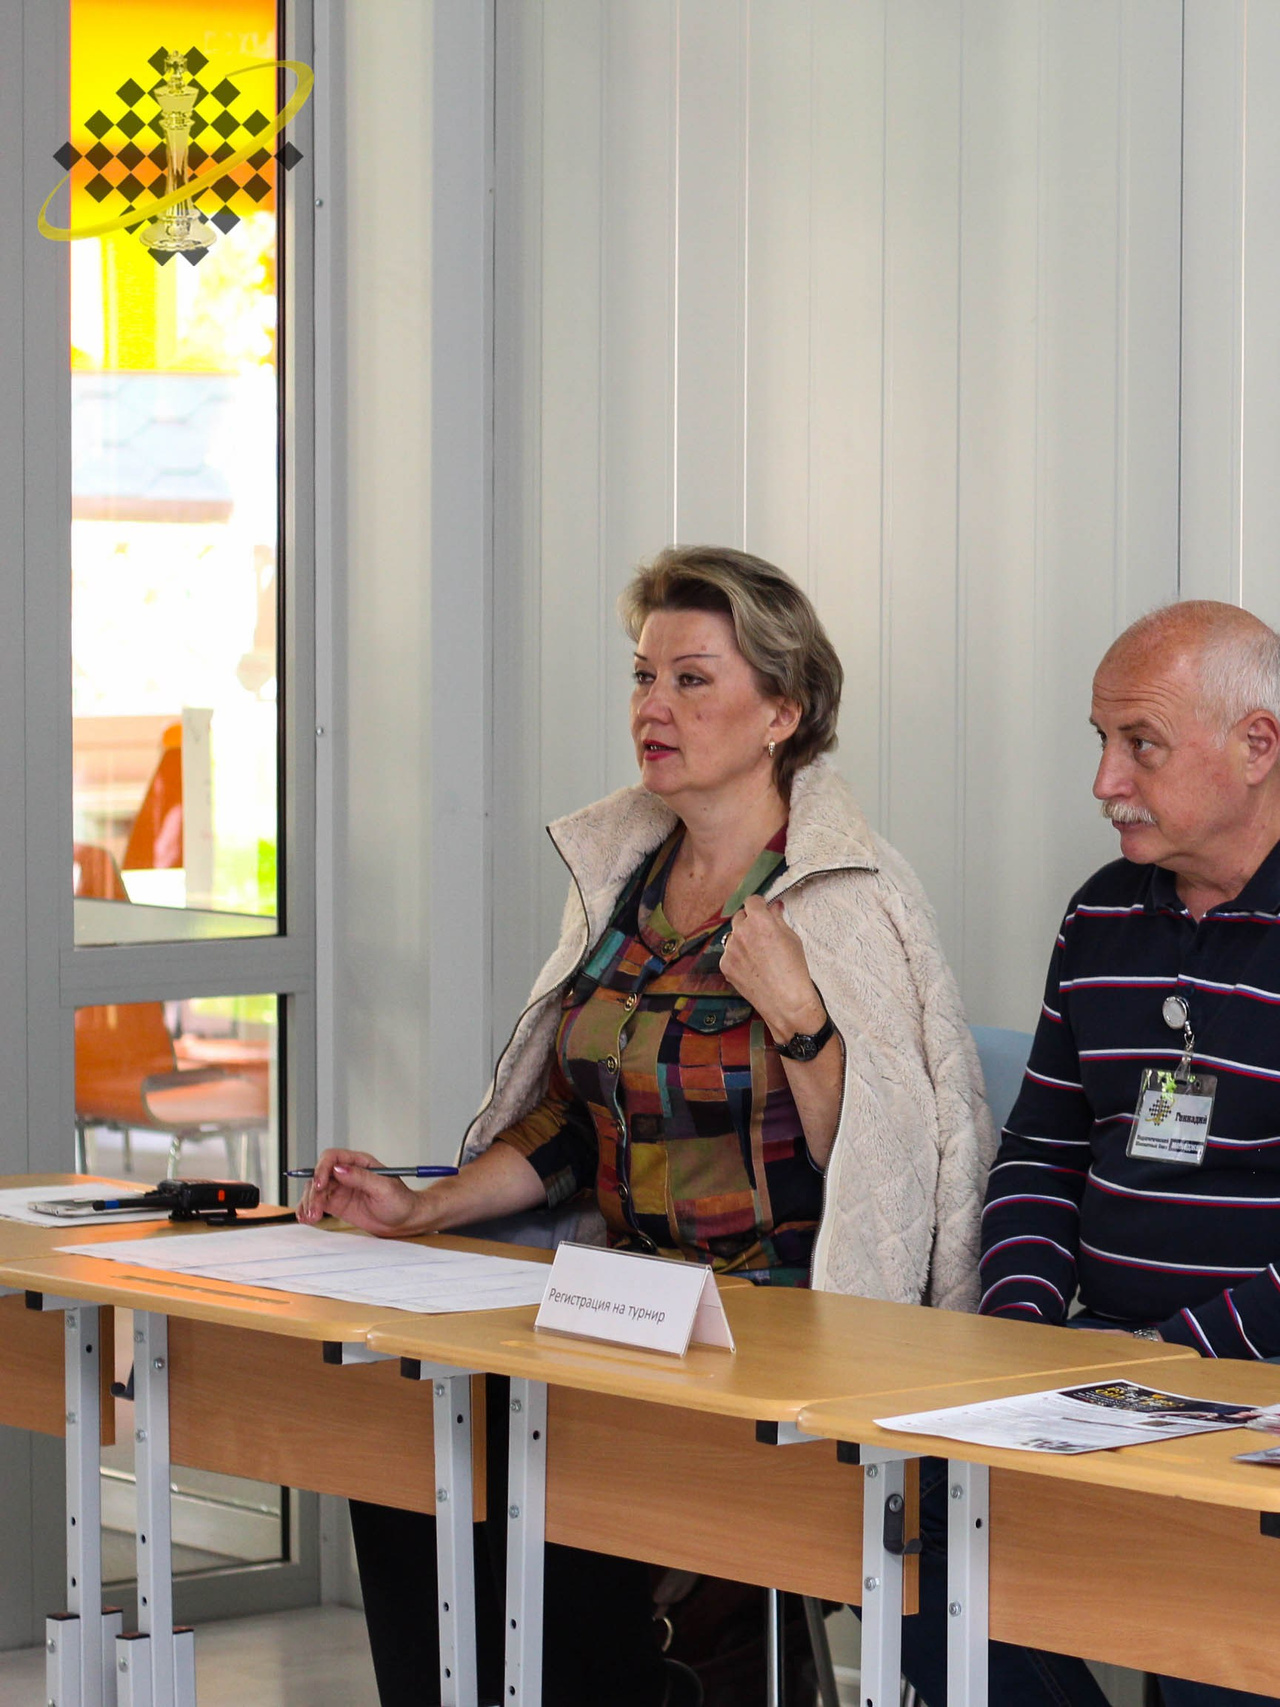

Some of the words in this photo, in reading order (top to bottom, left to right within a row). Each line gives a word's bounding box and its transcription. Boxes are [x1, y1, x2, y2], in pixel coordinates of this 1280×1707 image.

[549, 1287, 610, 1311] Регистрация
[612, 1303, 625, 1314] на
[629, 1305, 665, 1324] турнир
